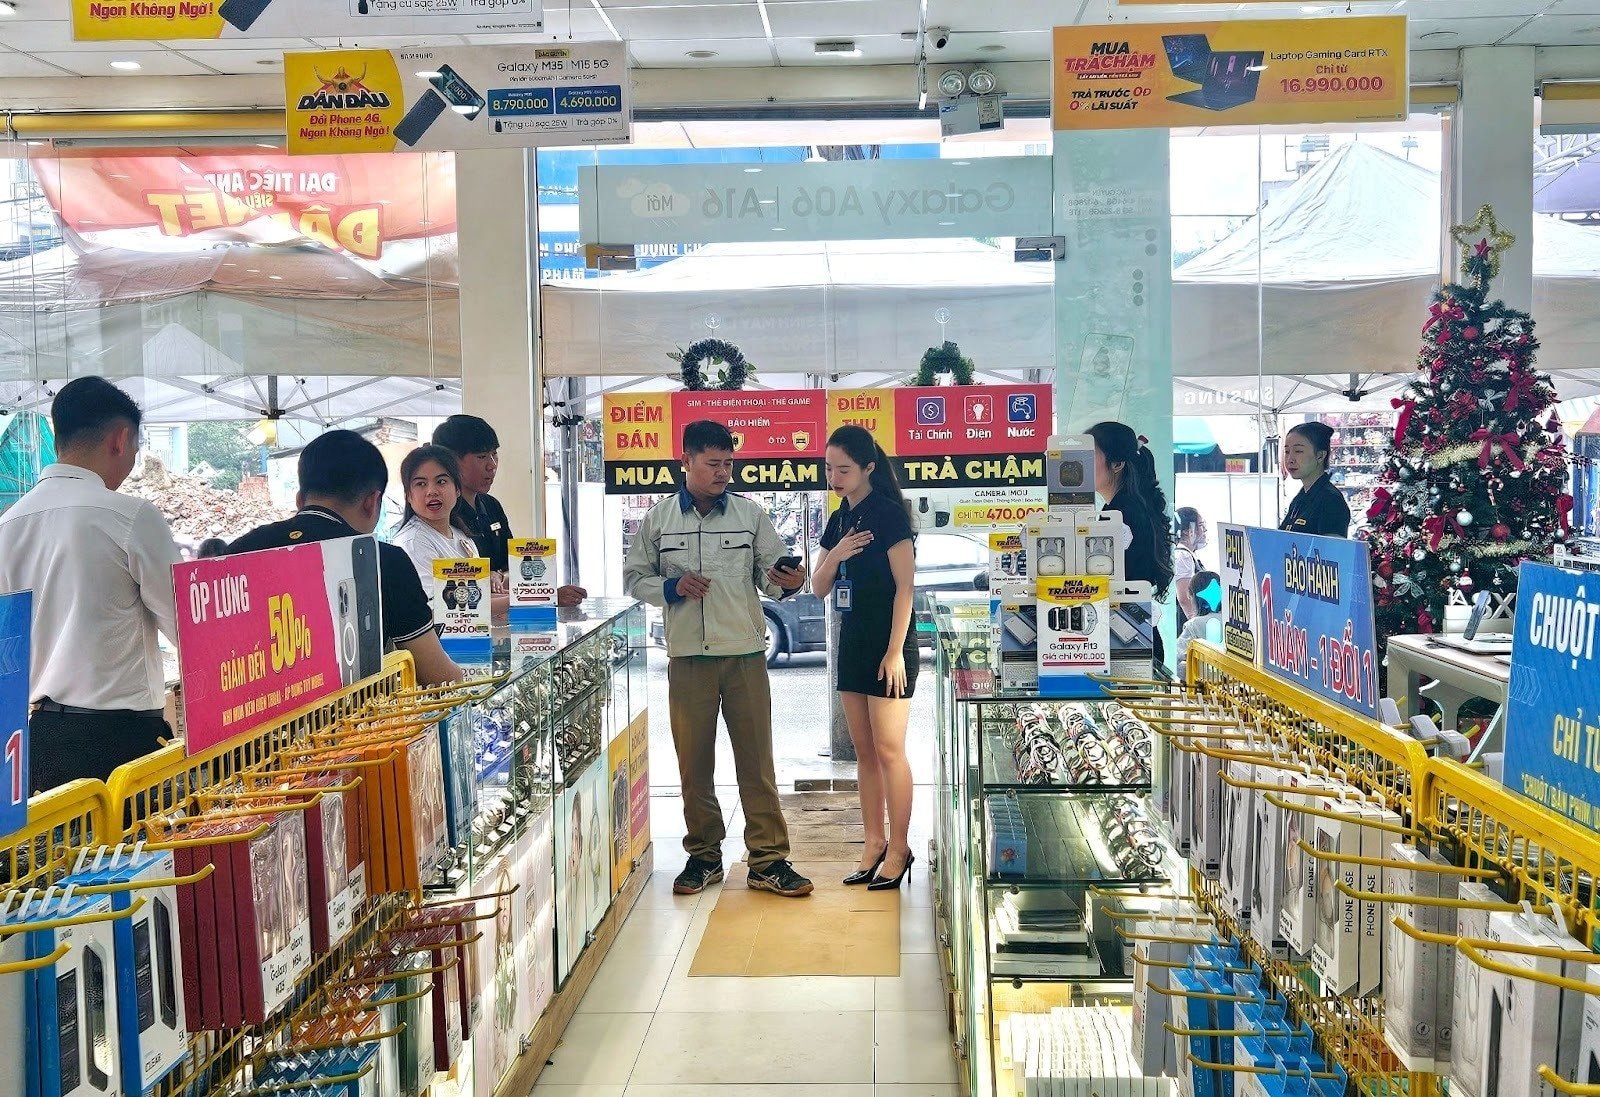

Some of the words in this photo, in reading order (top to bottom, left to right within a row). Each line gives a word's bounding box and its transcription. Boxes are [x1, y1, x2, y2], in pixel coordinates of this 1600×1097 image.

[90, 3, 127, 19] Ngon
[130, 2, 176, 19] Không
[1090, 42, 1130, 55] MUA
[1270, 51, 1303, 61] Laptop
[1306, 50, 1342, 60] Gaming
[1344, 49, 1366, 58] Card
[1368, 48, 1389, 57] RTX
[497, 62, 539, 74] Galaxy
[541, 60, 563, 71] M35
[571, 60, 590, 70] M15
[593, 59, 609, 69] 5G
[1315, 64, 1335, 74] Chỉ
[1336, 63, 1348, 73] từ
[1280, 76, 1384, 93] 16.990.000
[560, 95, 617, 108] 4.690.000
[1072, 89, 1092, 99] TRẢ
[1093, 88, 1131, 99] TRƯỚC
[492, 98, 549, 110] 8.790.000
[1069, 100, 1089, 111] 0%
[1109, 98, 1139, 110] SUẤT
[329, 114, 361, 125] Phone
[590, 118, 606, 128] góp
[300, 127, 326, 139] Ngon
[329, 126, 361, 138] Không
[687, 399, 701, 407] SIM
[706, 398, 722, 407] THẺ
[722, 397, 742, 408] ĐIỆN
[742, 398, 766, 407] THOẠI
[772, 397, 787, 406] THẺ
[788, 397, 811, 406] GAME
[837, 392, 880, 413] ĐIỂM
[610, 400, 663, 423] ĐIỂM
[727, 416, 747, 427] BẢO
[747, 416, 770, 427] HIỂM
[616, 429, 659, 449] BÁN
[768, 435, 774, 445] Ô
[775, 435, 786, 444] TÔ
[908, 429, 923, 440] Tài
[926, 428, 953, 440] Chính
[966, 427, 991, 441] Điện
[1007, 426, 1035, 438] Nước
[615, 466, 675, 486] MUA
[740, 459, 818, 489] CHẬM
[904, 455, 958, 481] TRẢ
[965, 455, 1043, 484] CHẬM
[1226, 531, 1245, 578] PHỤ
[1285, 543, 1306, 595] BẢO
[1308, 550, 1339, 602] HÀNH
[189, 567, 210, 625] ỐP
[214, 572, 250, 619] LƯNG
[1229, 579, 1250, 629] KIỆN
[267, 592, 312, 674] 50%
[1529, 585, 1600, 670] CHUỘT
[1049, 642, 1081, 651] Galaxy
[1262, 572, 1275, 666] 1
[1273, 608, 1309, 680] NĂM
[1319, 634, 1328, 689] 1
[1330, 619, 1362, 703] ĐỔI
[1363, 649, 1374, 708] 1
[1042, 651, 1057, 660] Giá
[1073, 652, 1106, 660] 990.000
[220, 650, 245, 693] GIẢM
[248, 641, 266, 682] ĐẾN
[1552, 707, 1584, 765] CHỈ
[4, 729, 23, 806] 1
[1345, 871, 1354, 896] ASE
[1367, 874, 1376, 894] ASE
[1344, 899, 1354, 933] PHONE
[1366, 903, 1376, 937] PHONE
[270, 963, 288, 981] Galaxy
